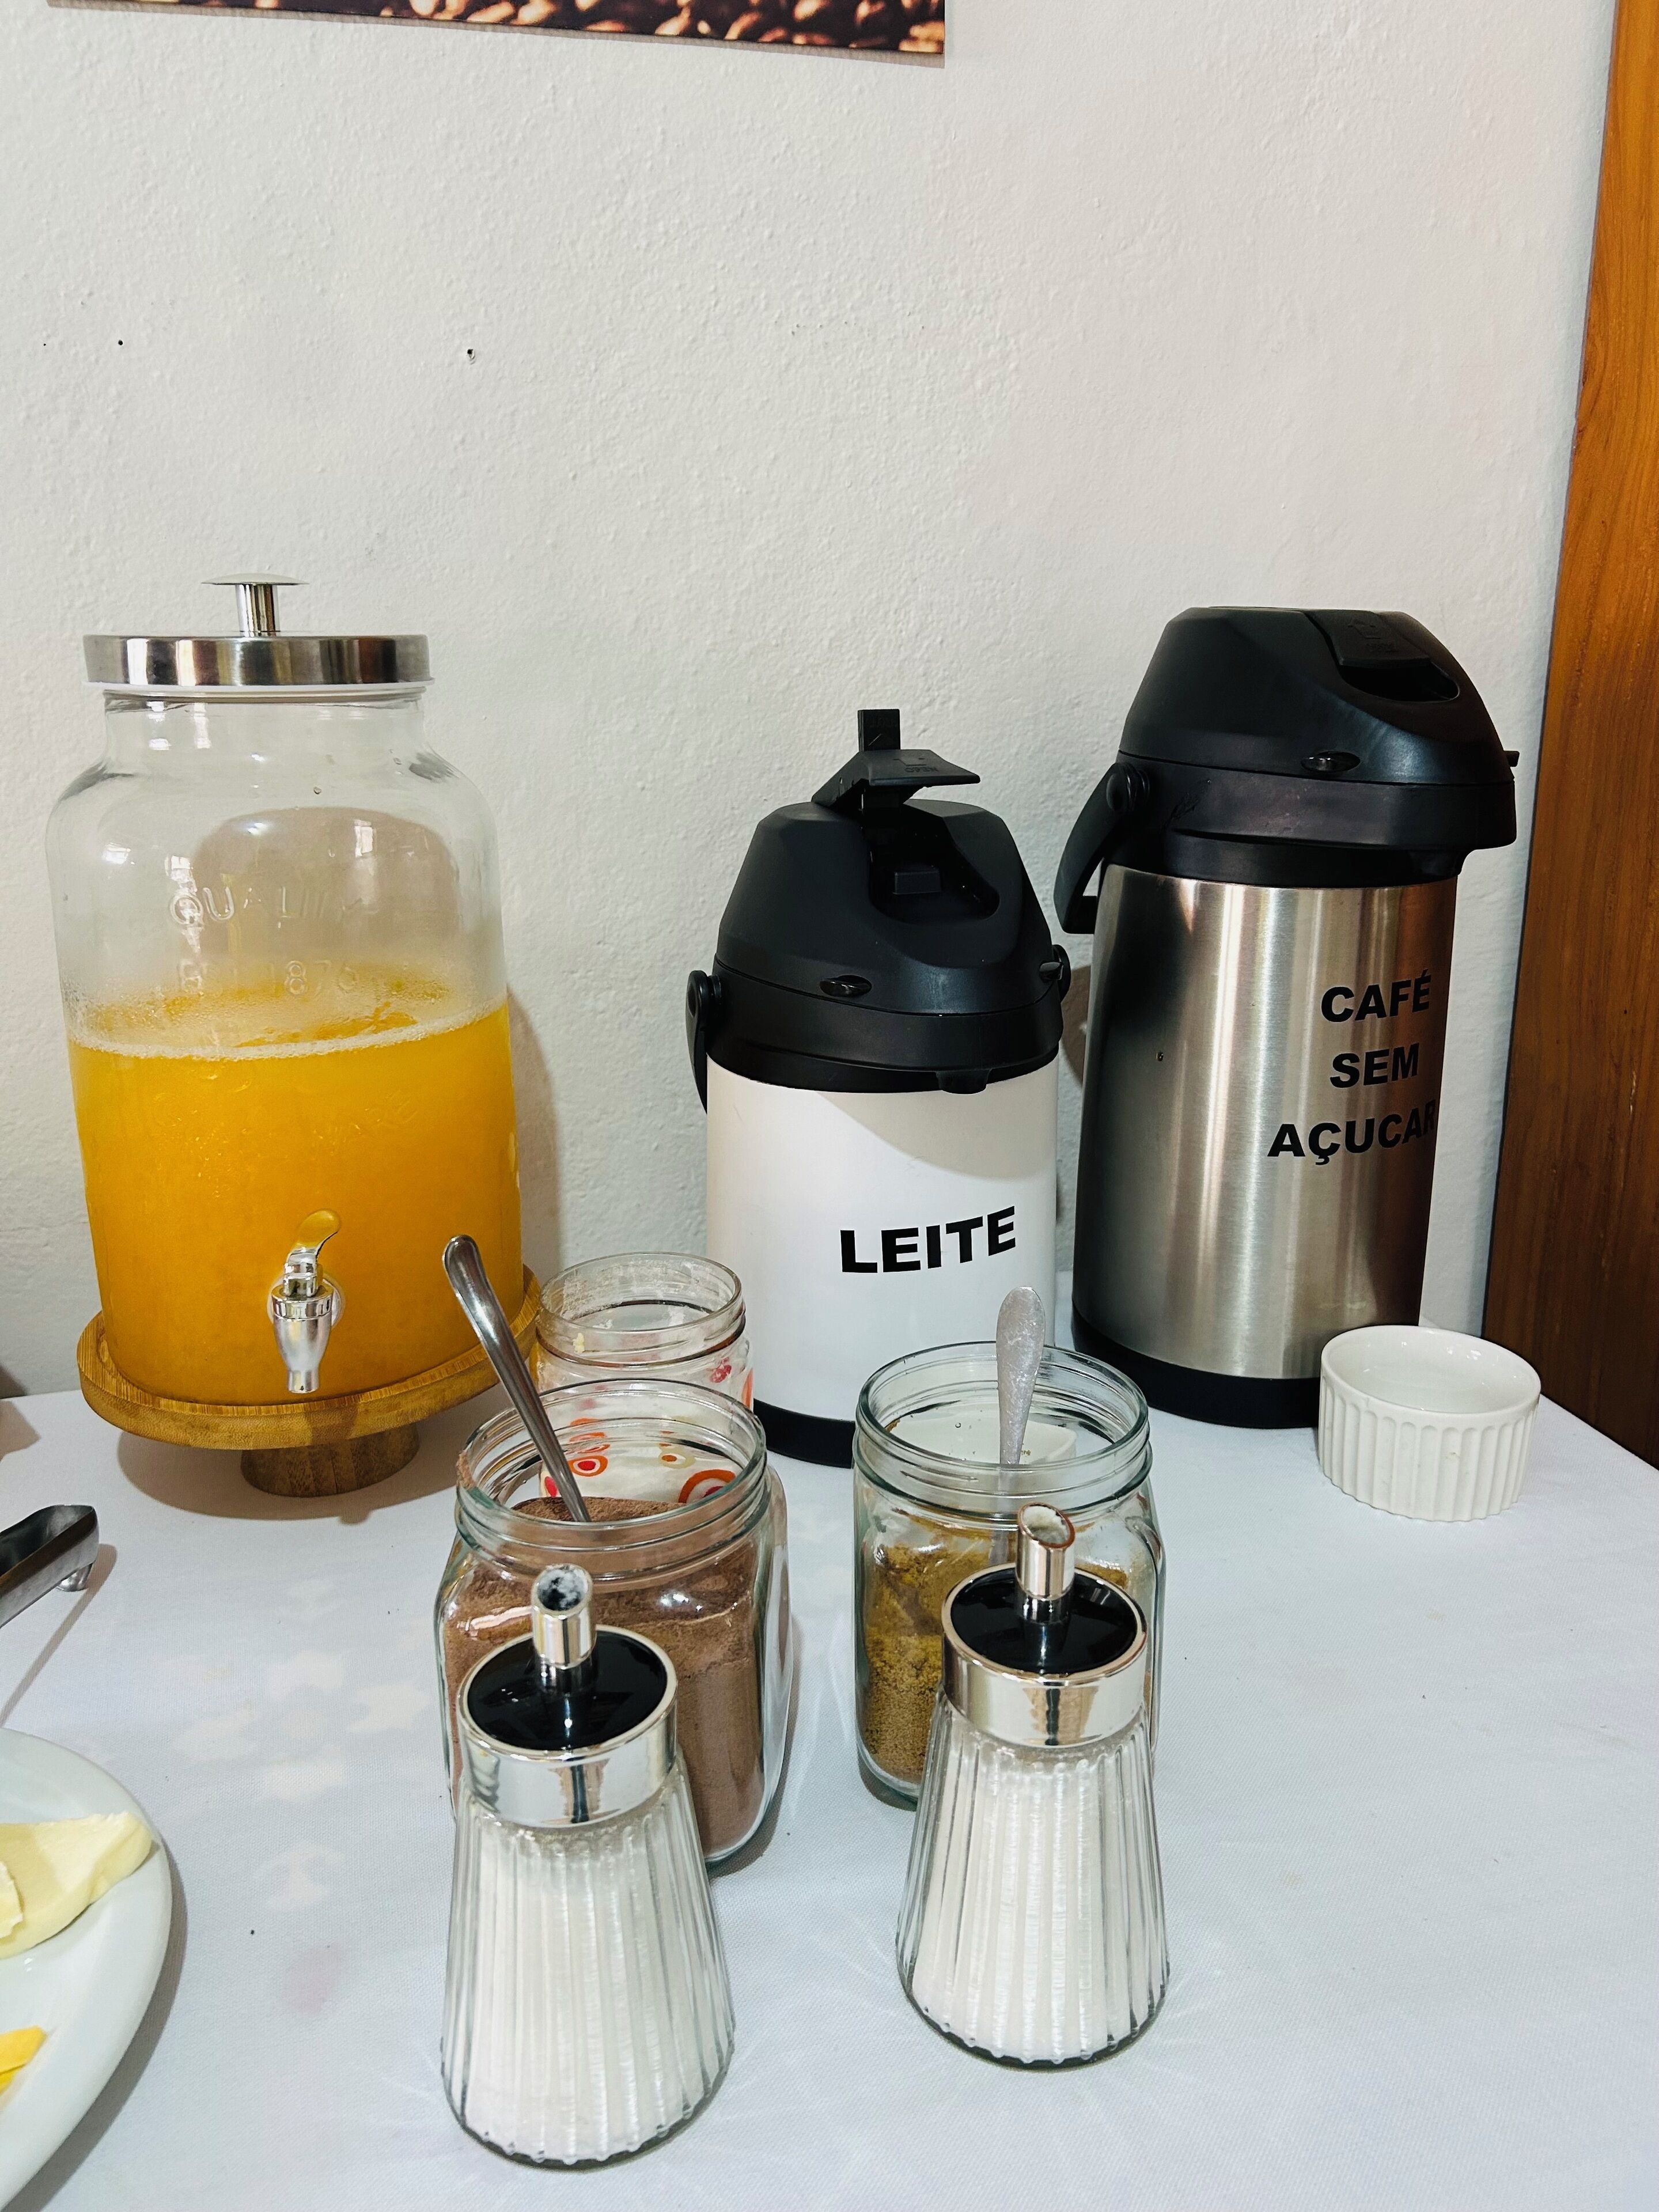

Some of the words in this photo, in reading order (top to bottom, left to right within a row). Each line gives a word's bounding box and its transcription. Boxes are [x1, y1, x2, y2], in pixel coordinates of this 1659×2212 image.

[1321, 968, 1432, 1023] CAFÉ
[1330, 1042, 1420, 1089] SEM
[1267, 1099, 1437, 1166] AÇUCAR
[840, 1205, 1016, 1274] LEITE
